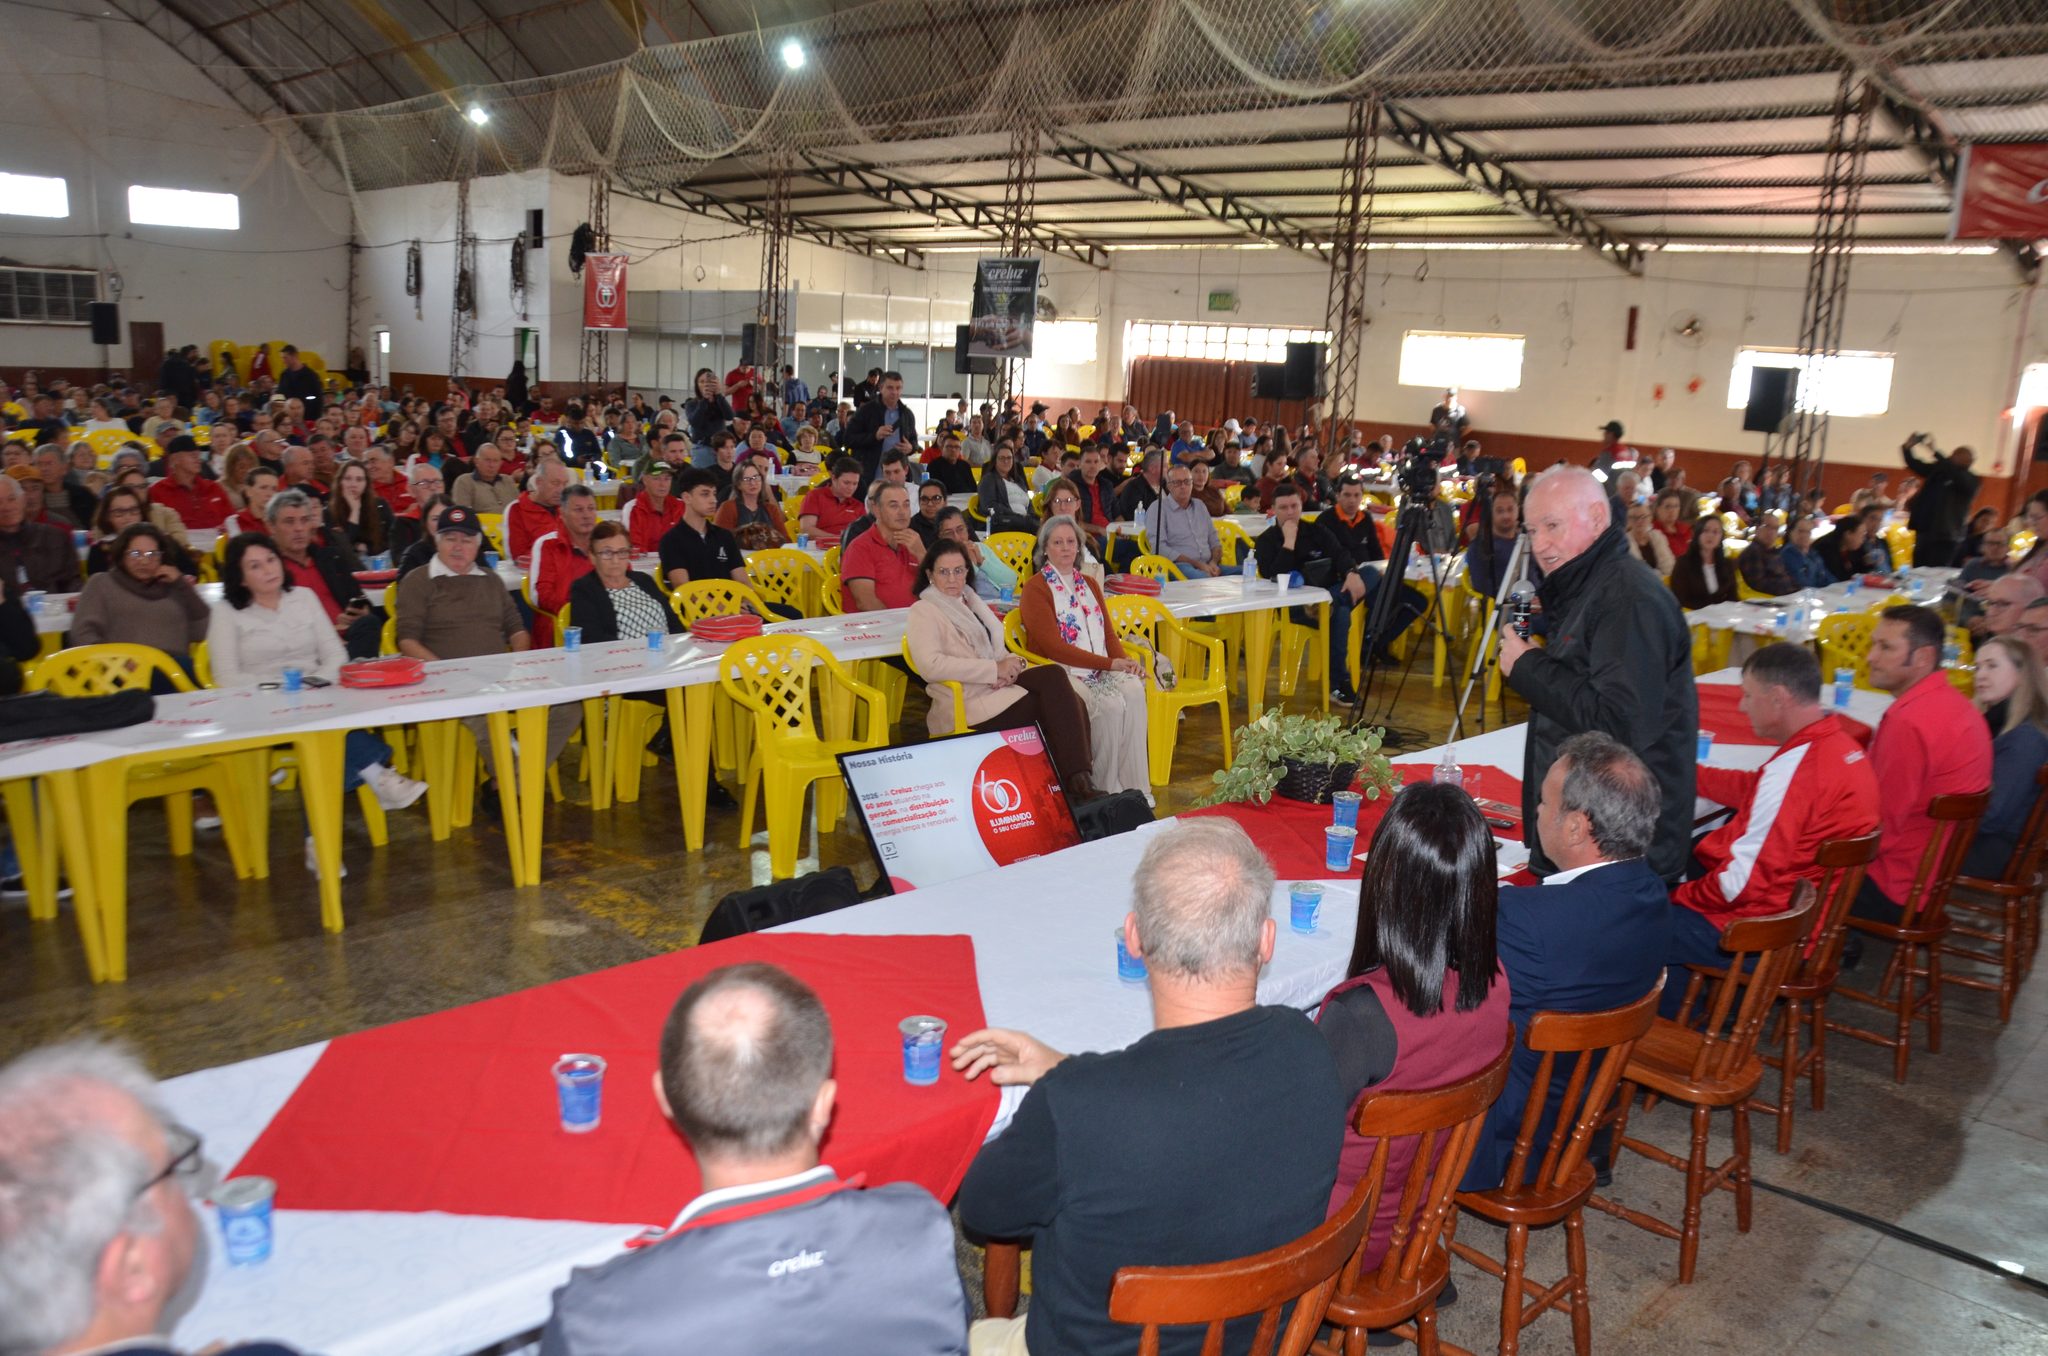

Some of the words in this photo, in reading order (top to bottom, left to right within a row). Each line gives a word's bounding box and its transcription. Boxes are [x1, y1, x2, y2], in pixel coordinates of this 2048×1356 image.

[1008, 730, 1037, 744] creluz
[849, 759, 877, 769] Nossa
[878, 752, 913, 765] História
[890, 786, 913, 796] Creluz
[876, 800, 894, 809] anos
[909, 798, 950, 812] distribuição
[882, 810, 938, 827] comercialização
[989, 812, 1032, 828] ILUMINANDO
[999, 824, 1010, 833] seu
[1010, 819, 1035, 831] caminho
